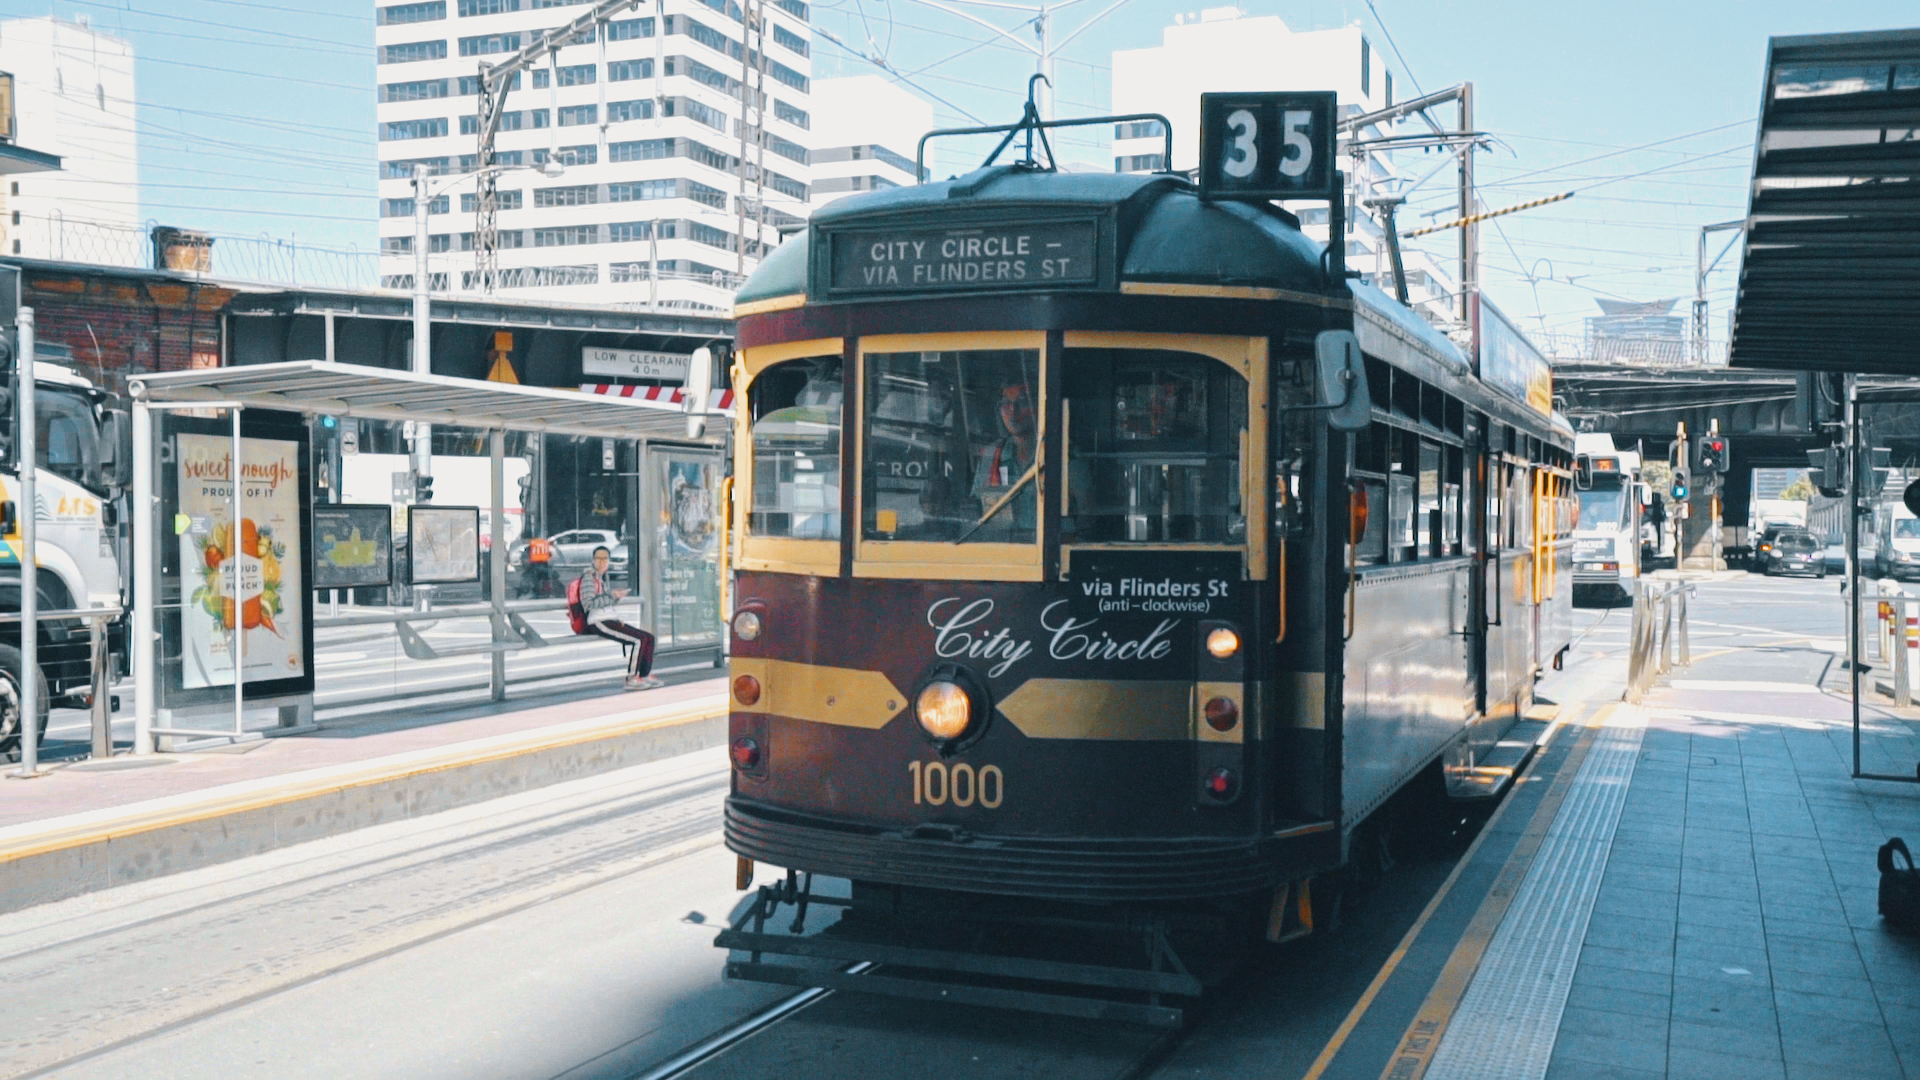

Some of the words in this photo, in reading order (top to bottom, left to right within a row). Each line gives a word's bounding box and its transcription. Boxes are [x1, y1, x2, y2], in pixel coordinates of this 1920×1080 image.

[871, 241, 925, 261] CITY
[942, 236, 1030, 258] CIRCLE
[863, 265, 899, 285] VIA
[913, 260, 1027, 283] FLINDERS
[1041, 258, 1071, 278] ST
[594, 351, 618, 362] LOW
[629, 354, 689, 367] CLEARANC
[632, 364, 660, 375] 4.0m
[184, 452, 232, 481] sweet
[241, 457, 293, 488] nough
[202, 487, 236, 498] PROU
[246, 488, 260, 498] OF
[264, 489, 274, 498] IT
[1082, 578, 1112, 596] via
[1120, 578, 1200, 597] Flinders
[1208, 579, 1229, 597] St
[927, 598, 1034, 678] City
[1041, 599, 1182, 660] Circle
[908, 760, 1003, 809] 1000
